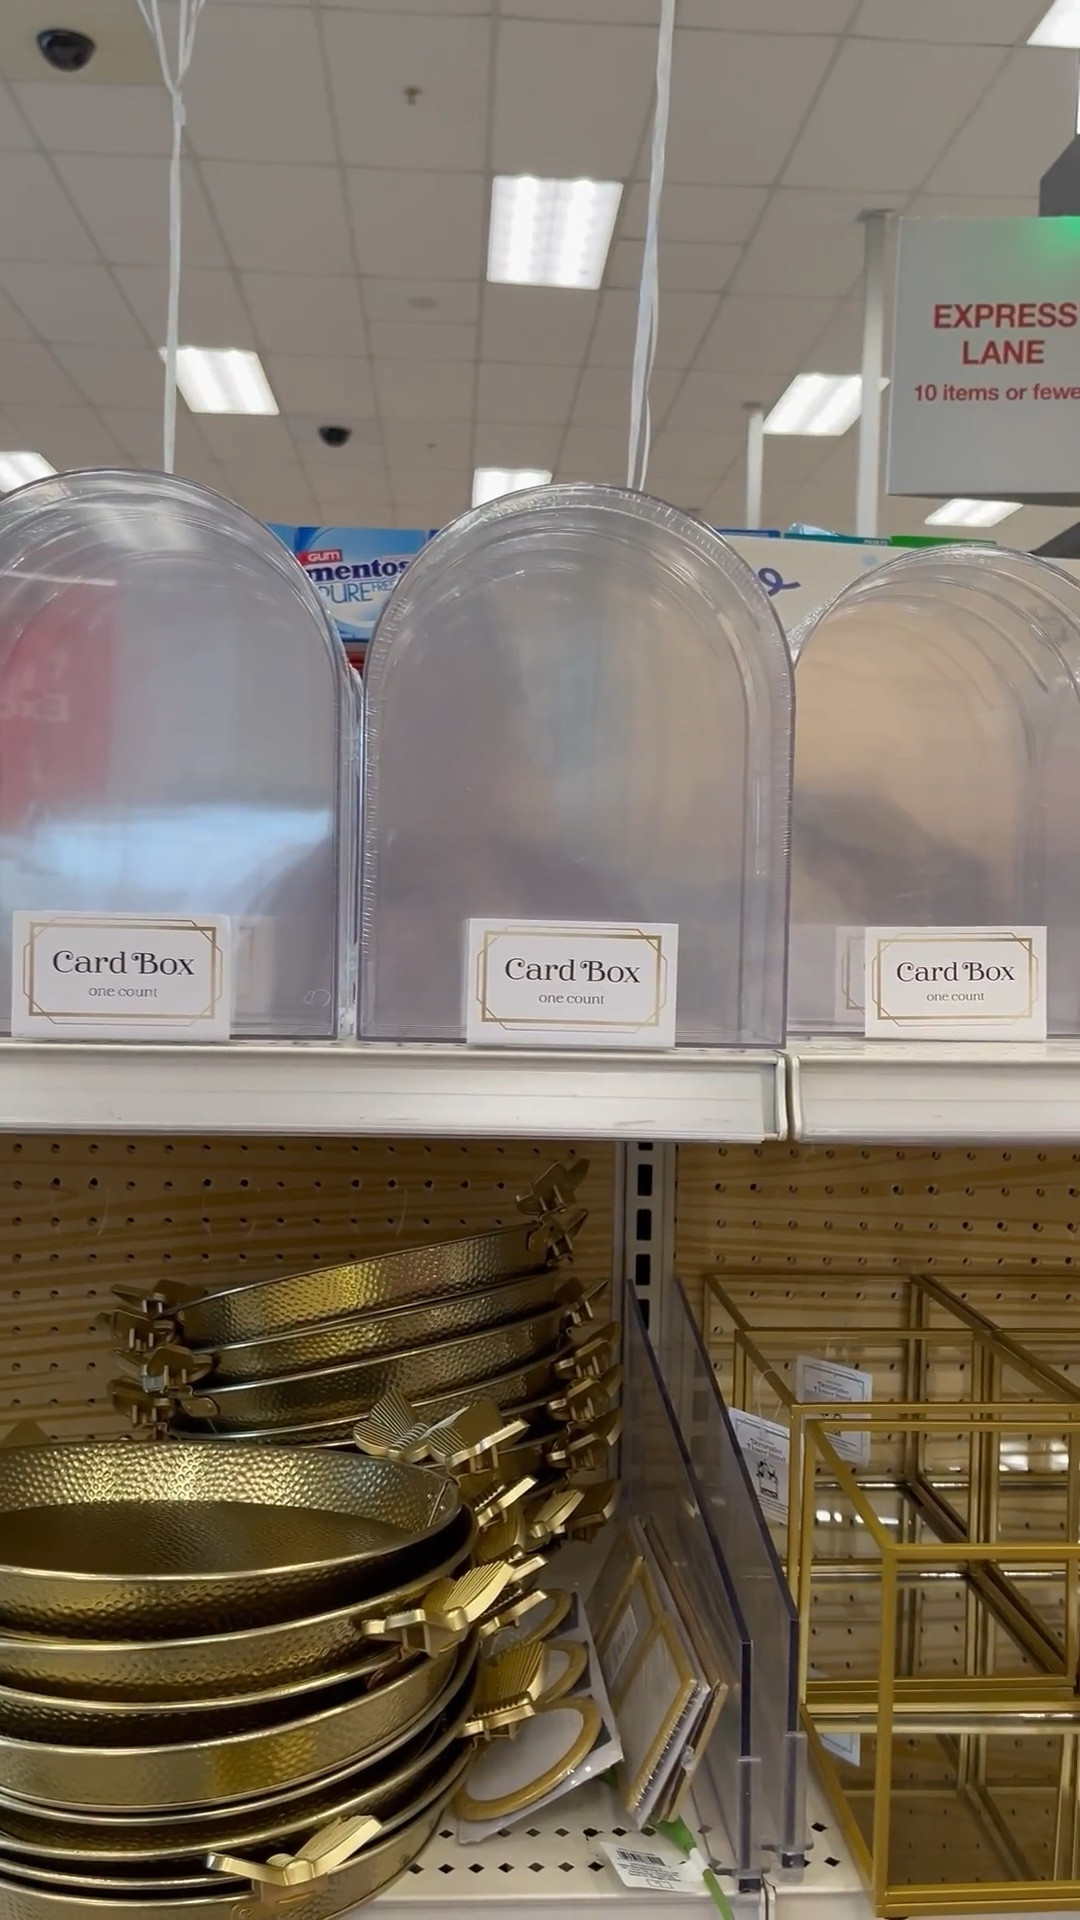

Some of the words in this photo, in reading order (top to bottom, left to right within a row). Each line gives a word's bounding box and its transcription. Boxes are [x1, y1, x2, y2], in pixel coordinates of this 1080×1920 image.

[933, 302, 1078, 329] EXPRESS
[962, 340, 1045, 365] LANE
[914, 384, 937, 401] 10
[943, 383, 999, 401] items
[1005, 386, 1027, 400] or
[1033, 383, 1080, 400] fewe
[53, 950, 128, 974] Card
[131, 951, 195, 976] Box
[505, 957, 576, 981] Card
[580, 960, 640, 983] Box
[896, 961, 960, 982] Card
[961, 961, 1016, 982] Box
[88, 985, 115, 997] one
[118, 987, 158, 998] count
[538, 993, 564, 1004] one
[566, 994, 605, 1005] count
[926, 992, 949, 1002] one
[951, 991, 985, 1002] count
